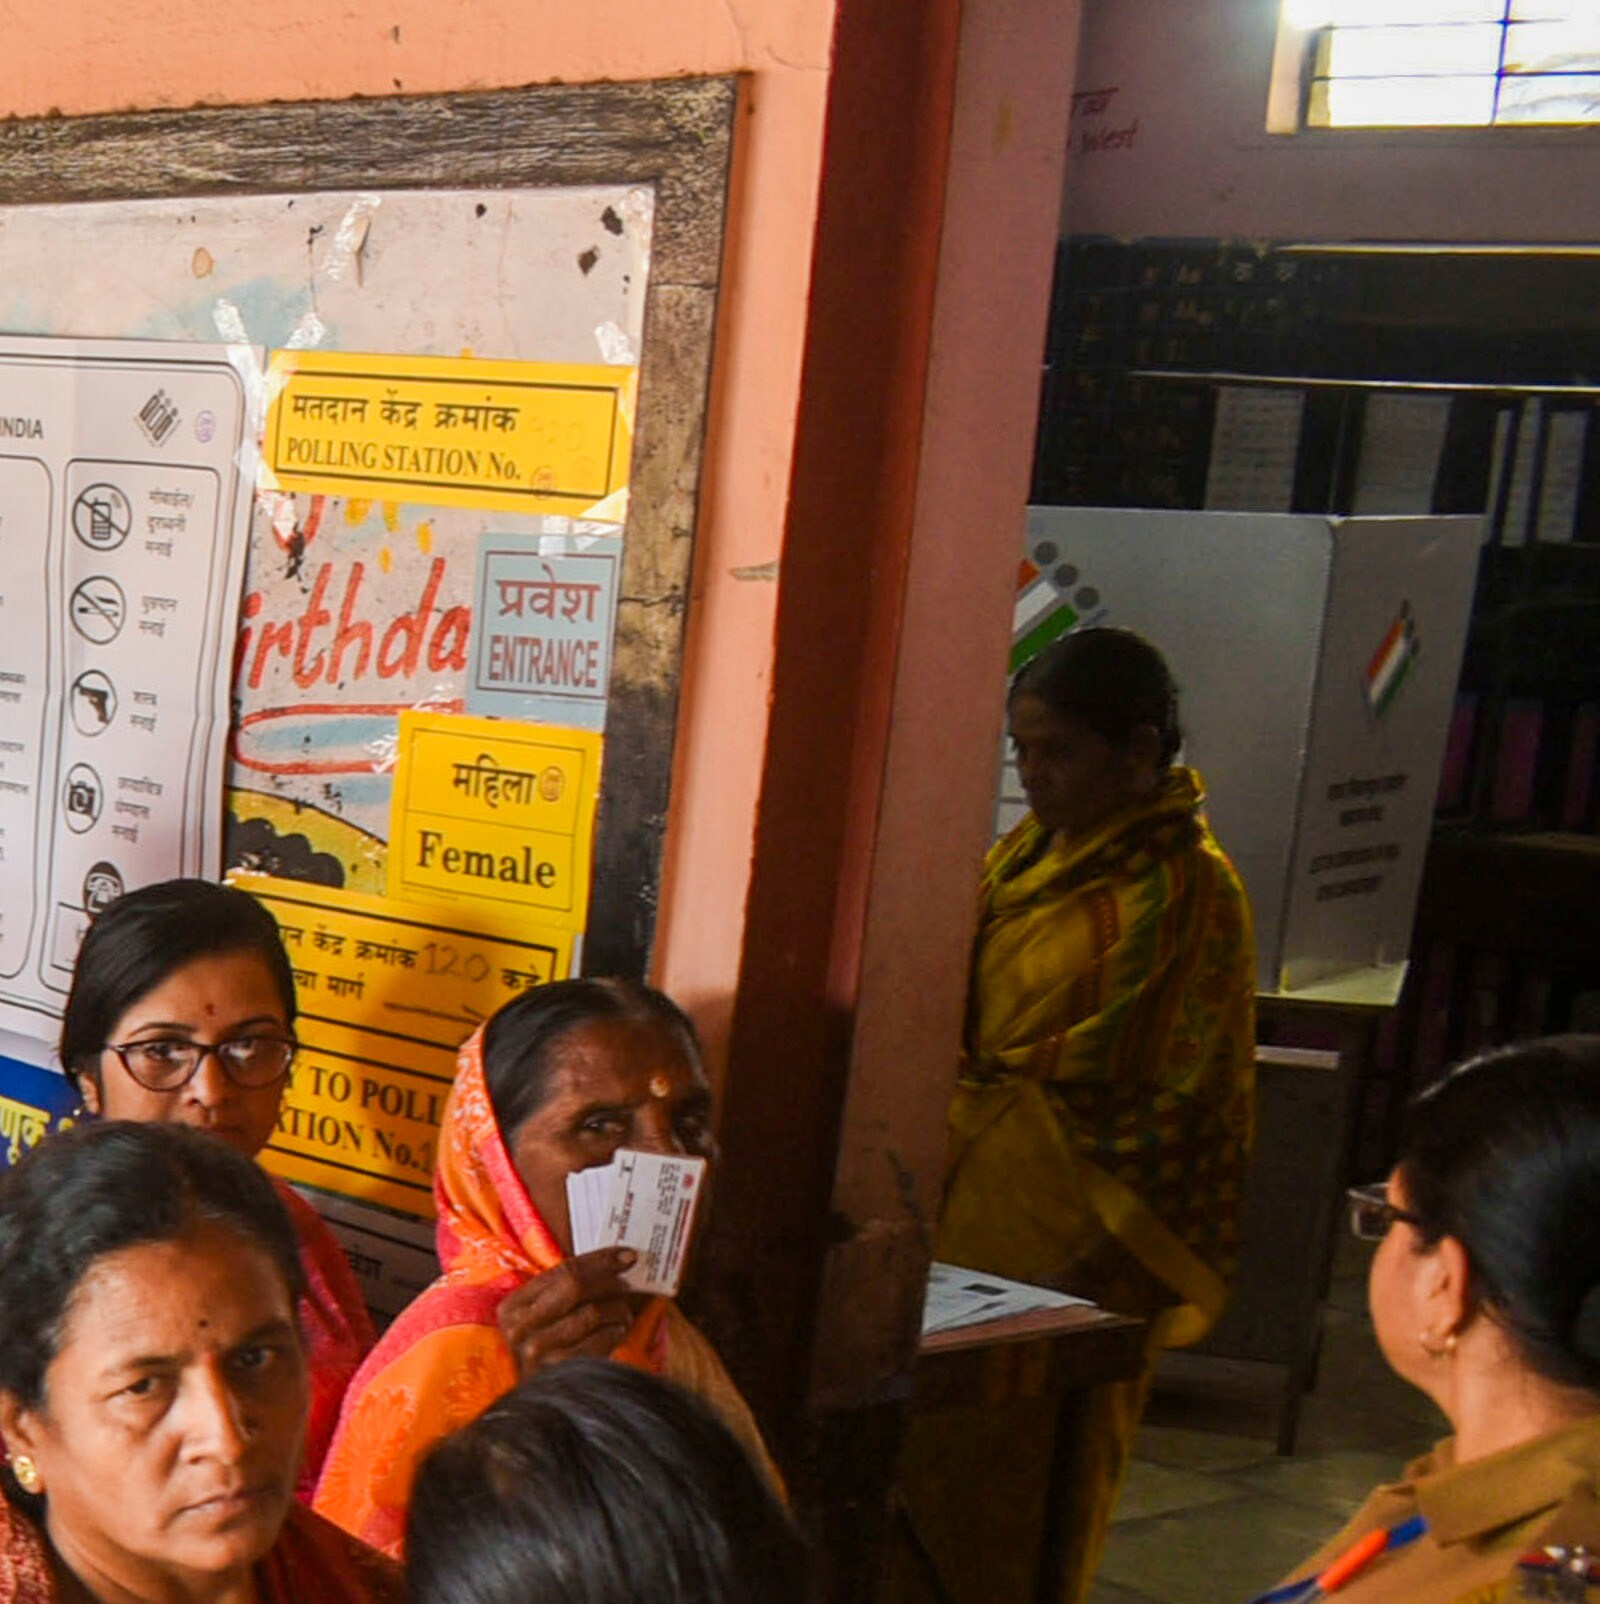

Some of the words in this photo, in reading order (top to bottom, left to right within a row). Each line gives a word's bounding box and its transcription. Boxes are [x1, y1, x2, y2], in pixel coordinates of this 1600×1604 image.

[291, 394, 370, 425] मतदान
[379, 387, 423, 431] केंद्र
[433, 393, 522, 434] क्रमांक
[286, 436, 378, 471] POLLING
[381, 443, 484, 478] STATION
[486, 451, 523, 482] No.
[494, 563, 601, 625] प्रवेश
[232, 556, 472, 692] irthda
[488, 634, 599, 691] ENTRANCE
[452, 753, 538, 808] महिला
[415, 831, 557, 890] Female
[311, 923, 348, 957] केंद्र
[354, 938, 420, 970] क्रमांक
[422, 941, 492, 983] 120
[325, 971, 365, 1001] मार्ग
[309, 1065, 352, 1103] TO
[359, 1078, 441, 1128] POLL
[278, 1106, 362, 1154] TION
